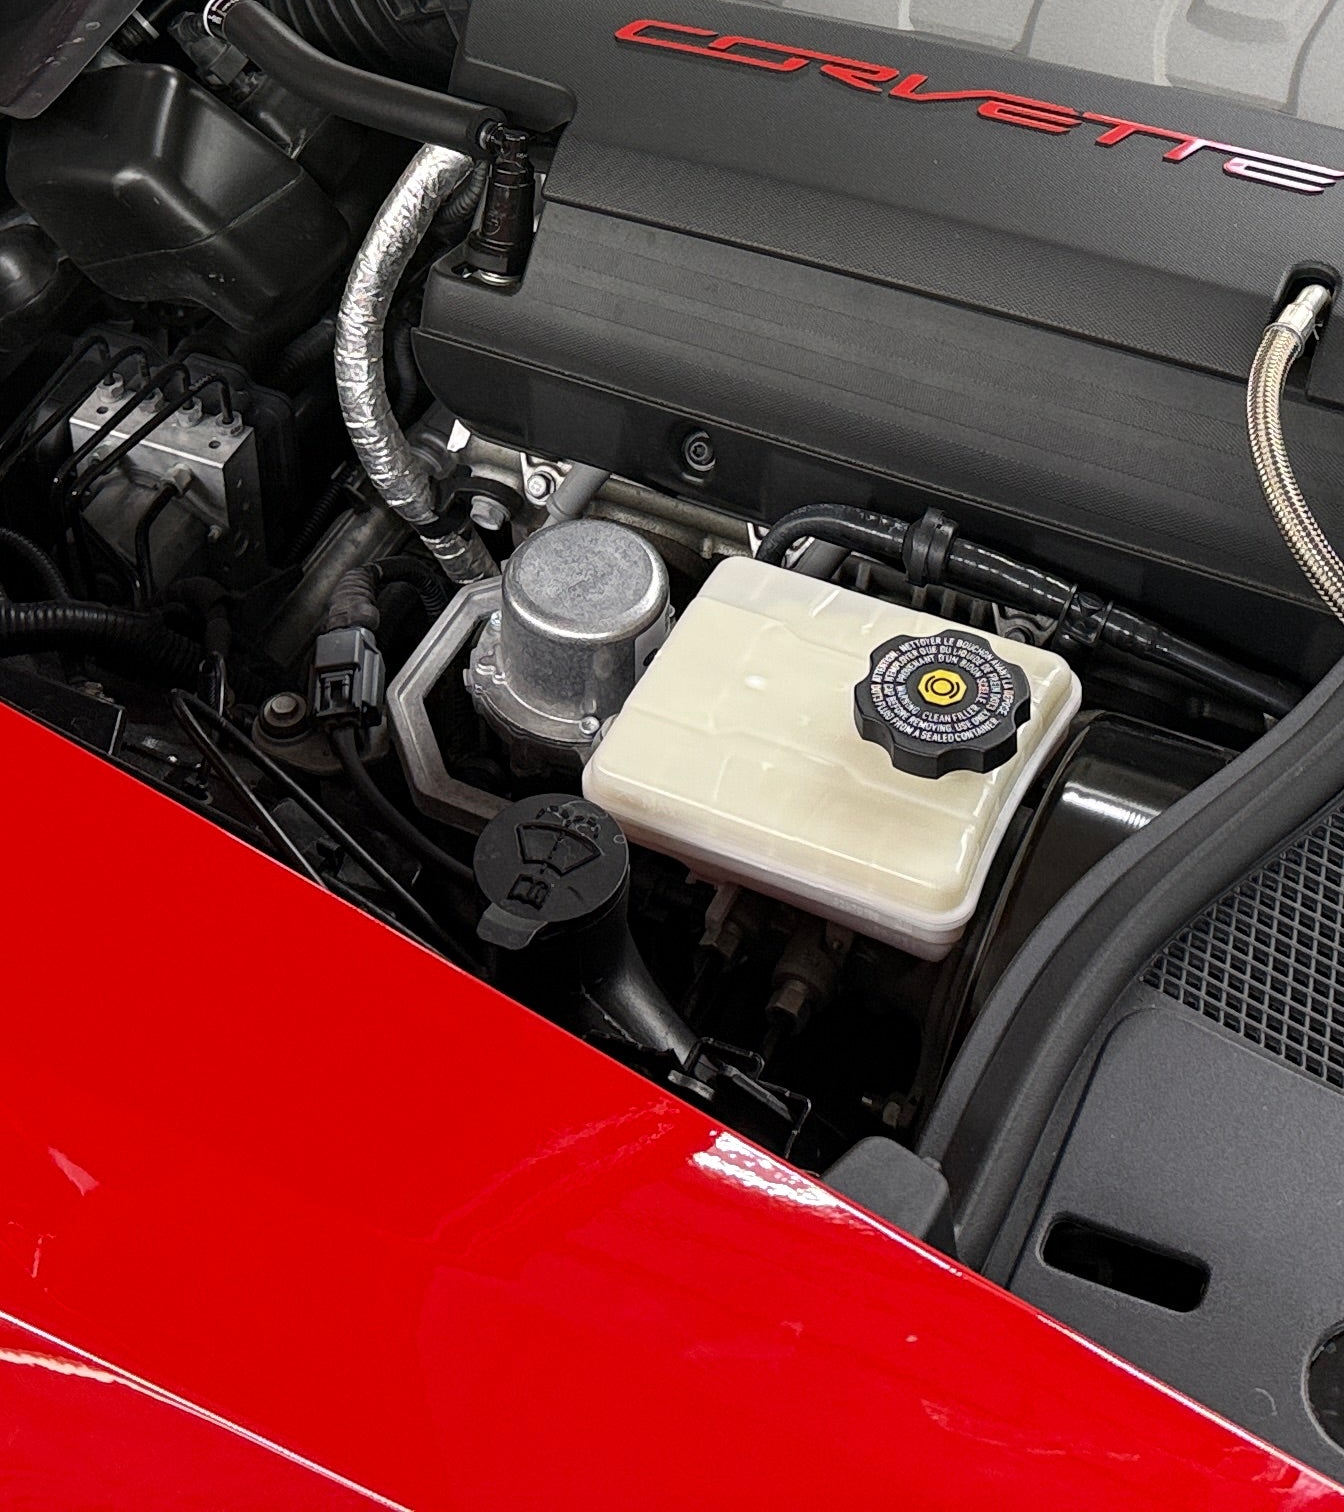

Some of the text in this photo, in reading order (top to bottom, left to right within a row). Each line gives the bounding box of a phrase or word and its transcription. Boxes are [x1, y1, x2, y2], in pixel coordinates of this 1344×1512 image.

[899, 637, 941, 653] NETTOYER
[943, 637, 955, 647] LE
[956, 639, 993, 661] BOUCHON
[990, 657, 1012, 679] AVANT
[1001, 678, 1014, 689] LA
[918, 645, 938, 656] QUE
[939, 645, 952, 654] DU
[953, 648, 984, 666] LIQUIDE
[981, 662, 994, 674] DE
[937, 654, 959, 664] D'UN
[959, 658, 984, 678] BIDON
[885, 695, 911, 721] BEFORE
[954, 720, 973, 732] USE
[970, 708, 992, 726] ONLY
[921, 711, 952, 723] CLEAN
[951, 703, 981, 722] FILLER
[889, 717, 915, 736] FROM
[912, 728, 922, 738] A
[920, 730, 955, 743] SEALED
